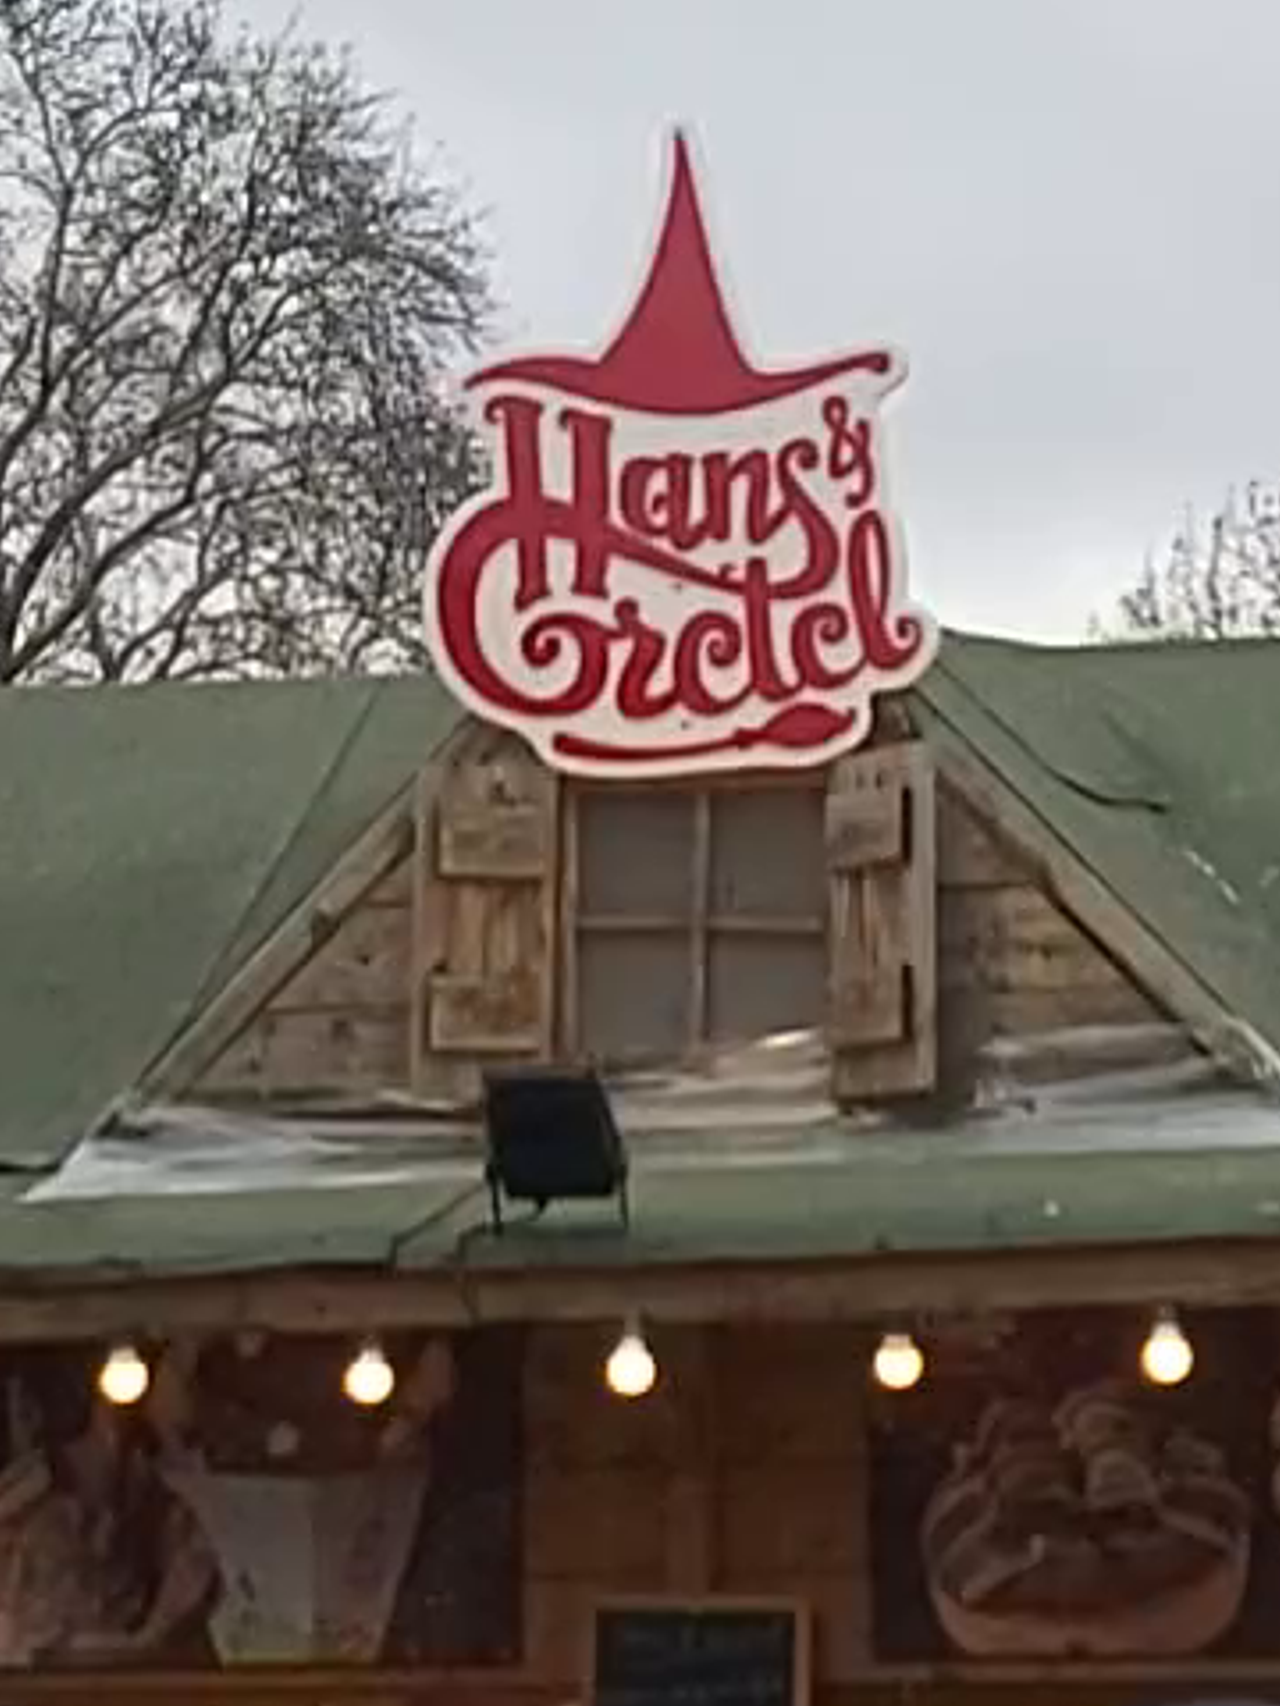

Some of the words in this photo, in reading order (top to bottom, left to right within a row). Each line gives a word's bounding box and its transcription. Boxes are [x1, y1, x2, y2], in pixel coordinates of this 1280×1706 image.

[437, 496, 923, 720] Gretel
[484, 394, 839, 610] Hans
[822, 395, 874, 508] &
